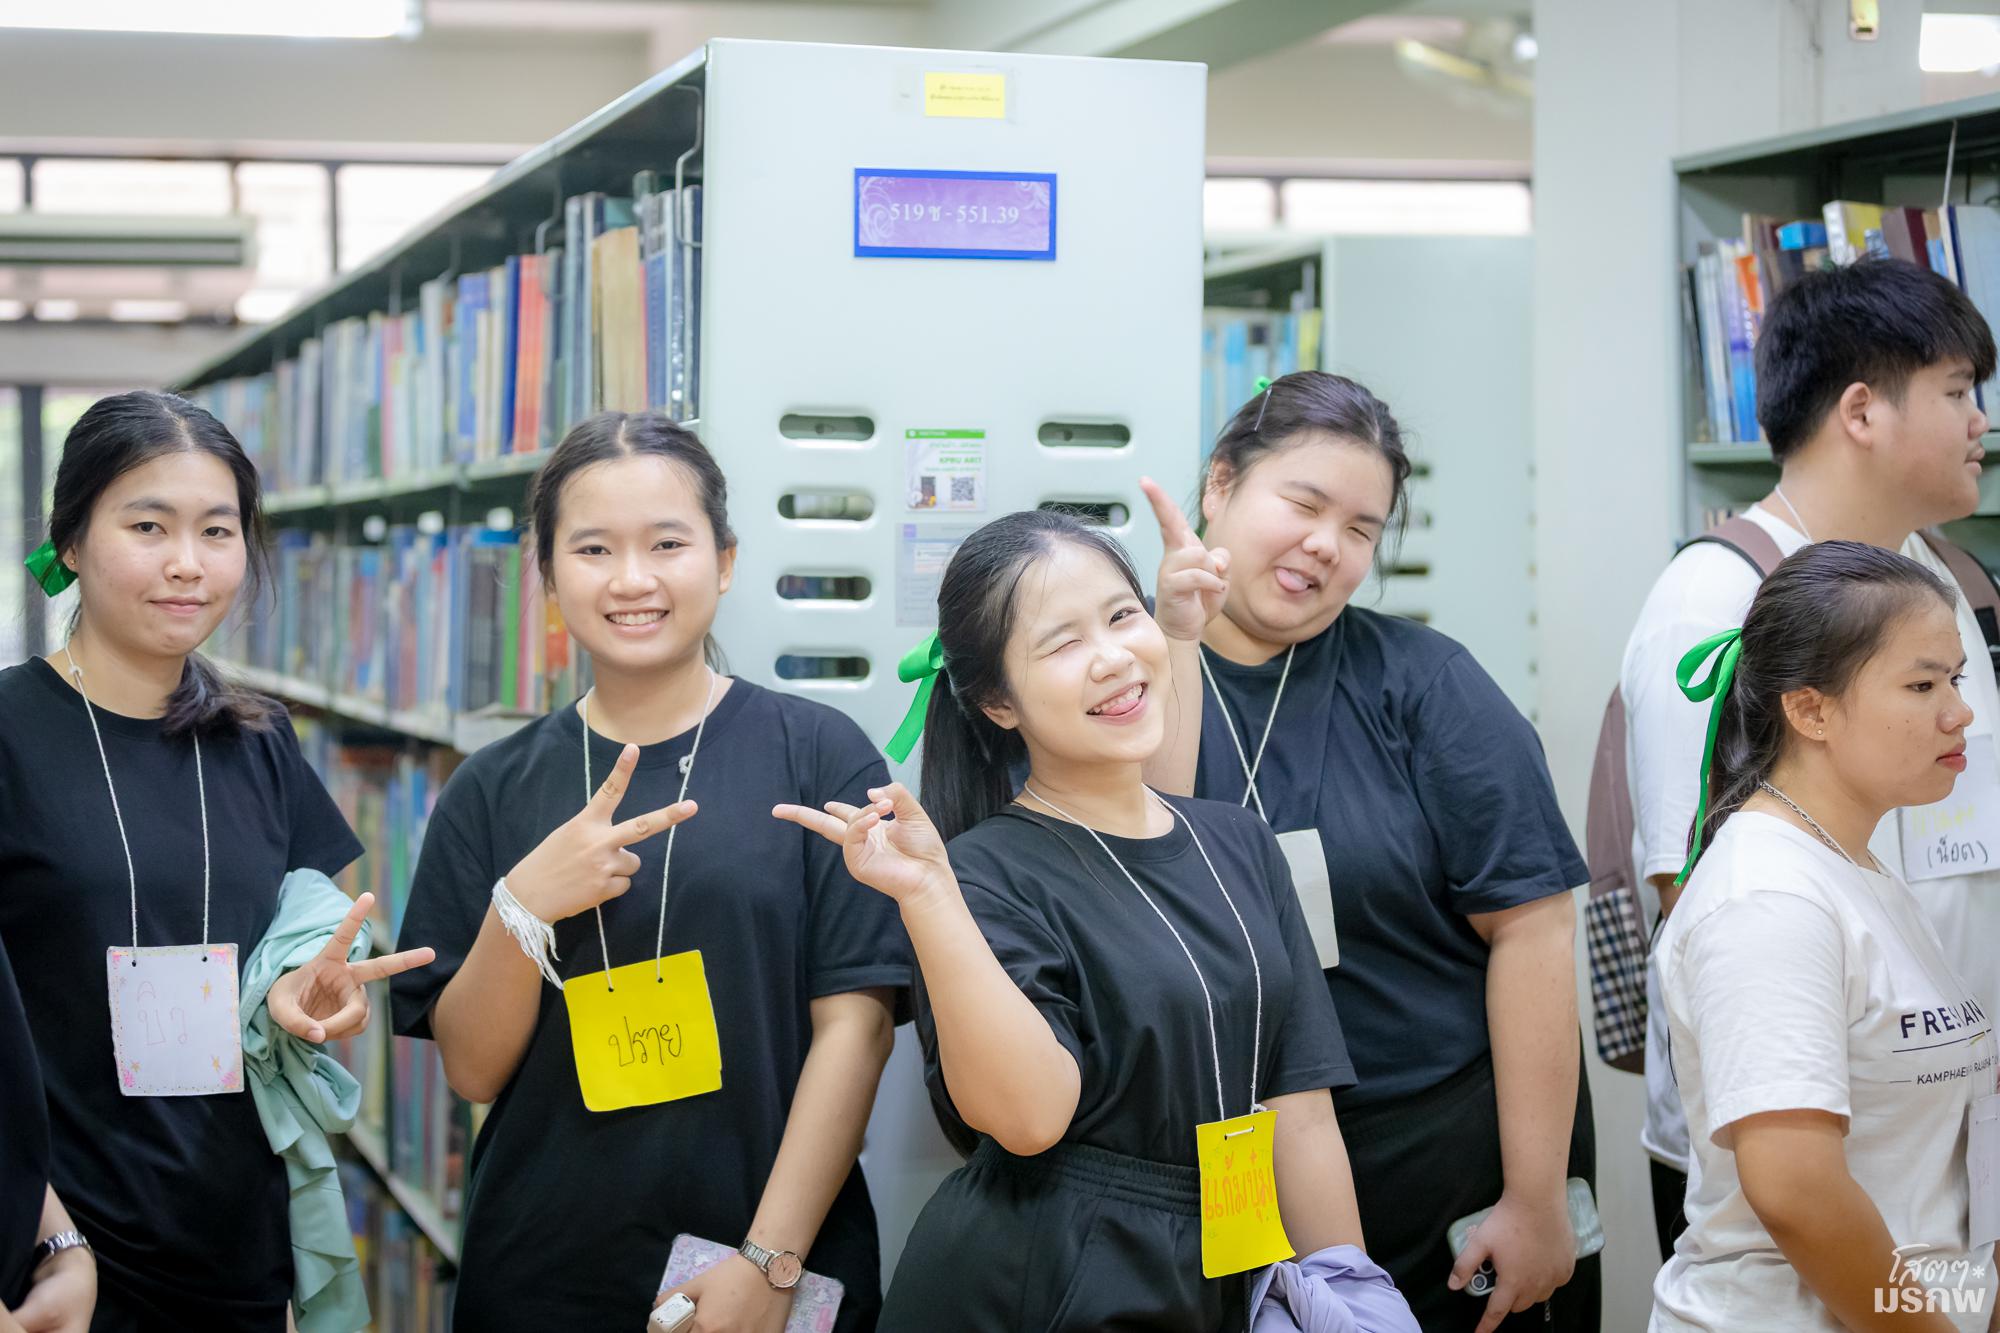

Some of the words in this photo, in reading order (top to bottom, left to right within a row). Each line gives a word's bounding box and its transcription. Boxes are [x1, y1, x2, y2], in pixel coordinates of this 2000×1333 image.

[890, 203, 925, 221] 519
[956, 205, 1020, 225] 551.39
[608, 1015, 683, 1068] ปราย
